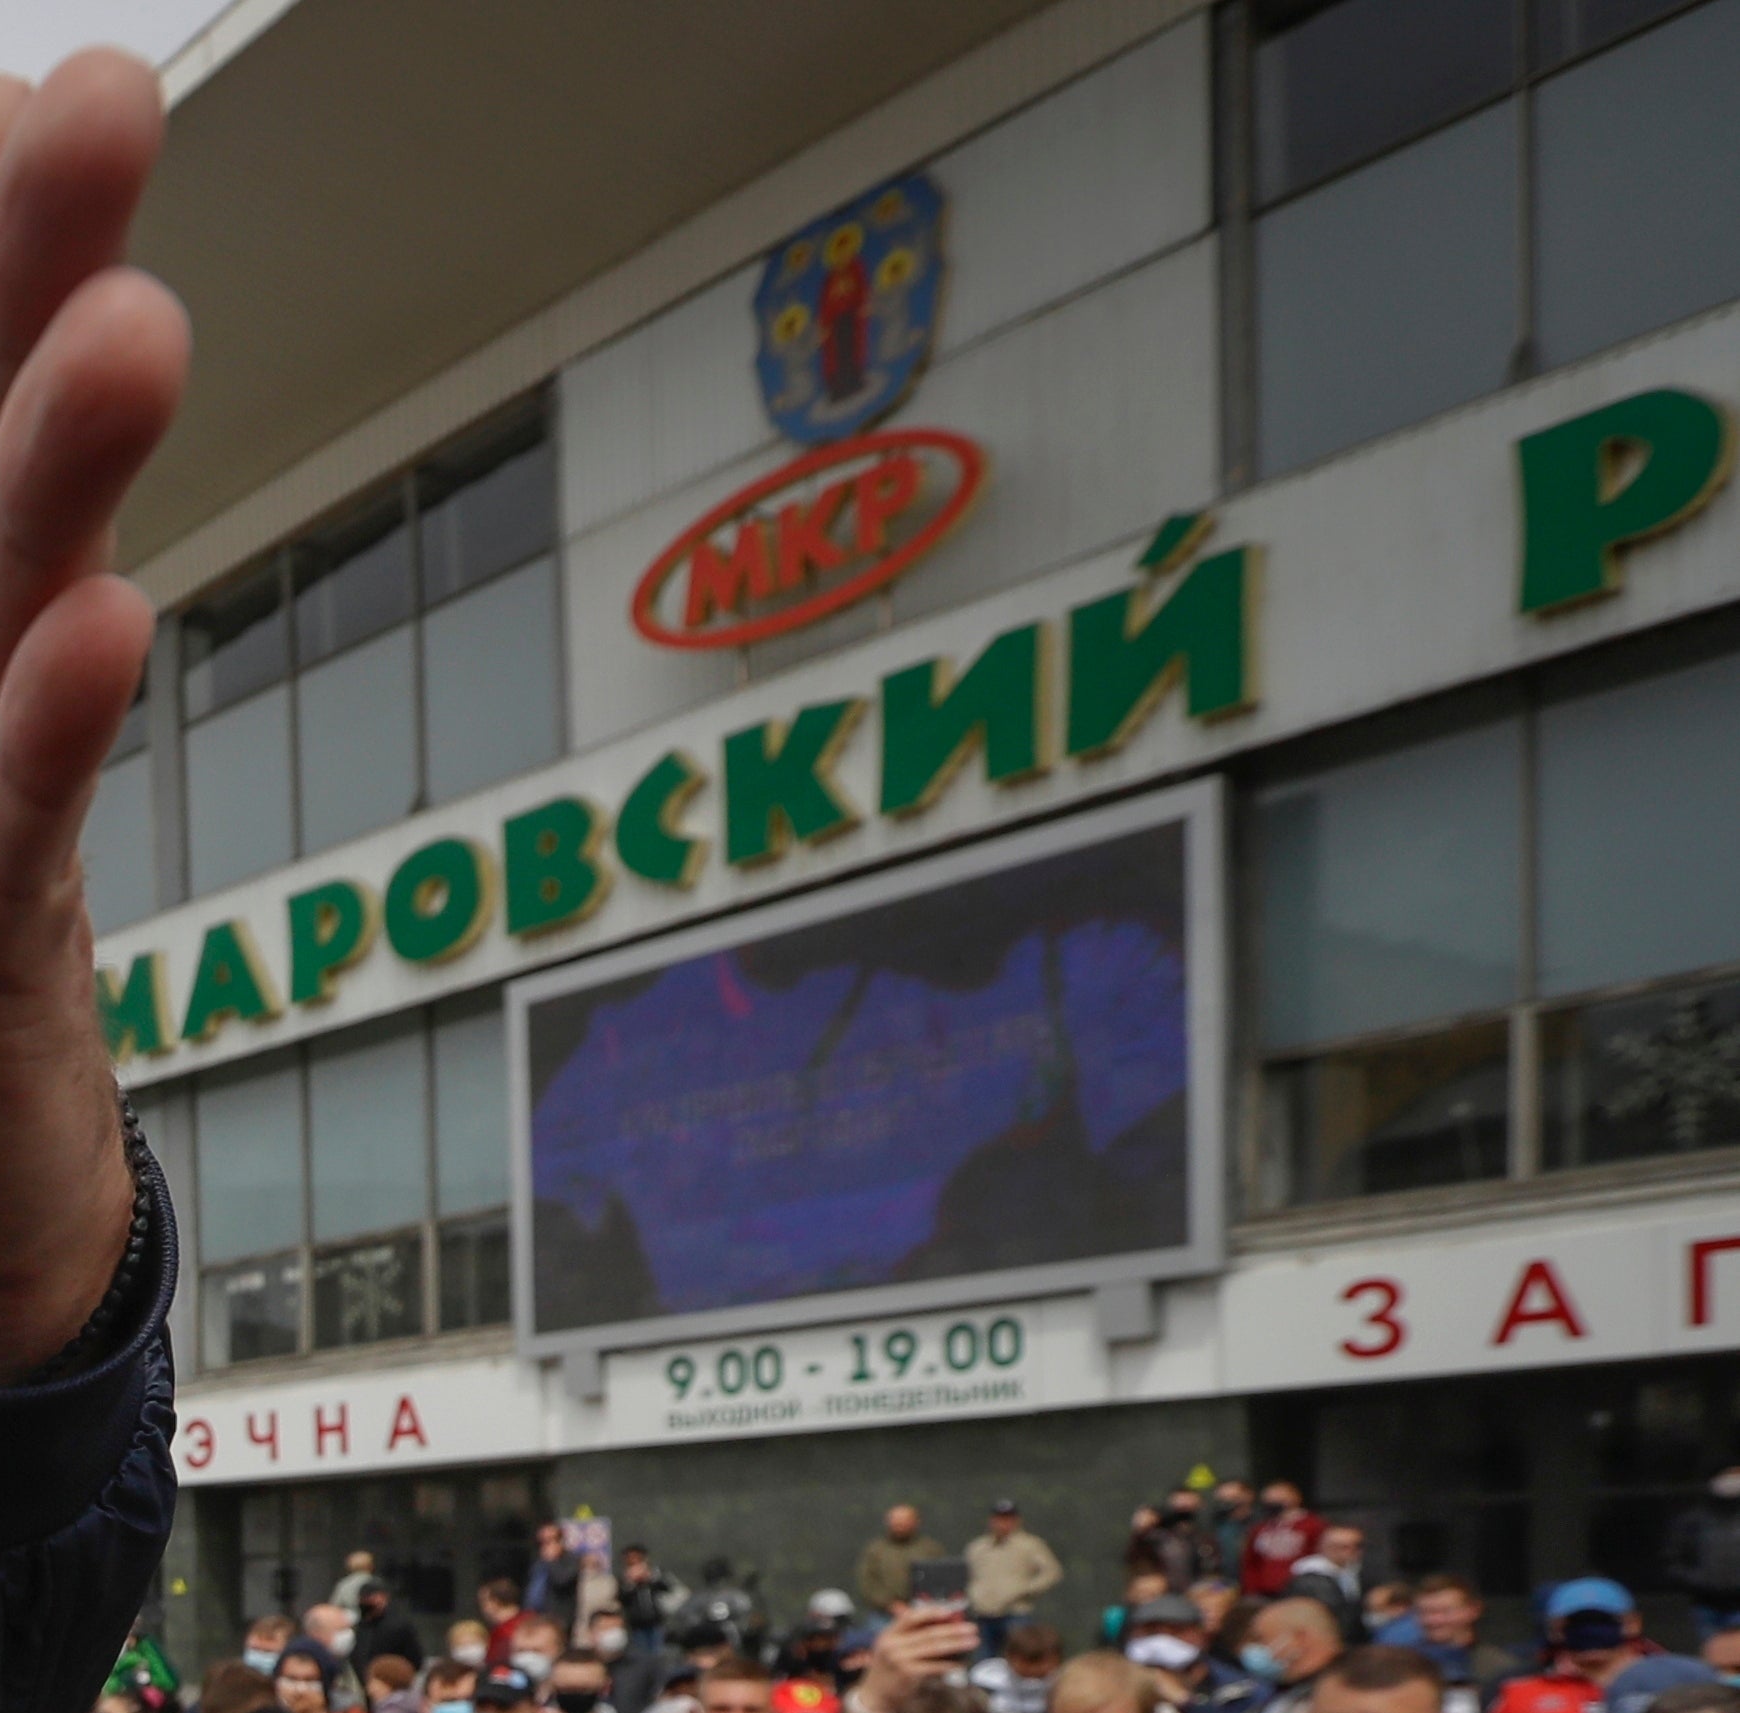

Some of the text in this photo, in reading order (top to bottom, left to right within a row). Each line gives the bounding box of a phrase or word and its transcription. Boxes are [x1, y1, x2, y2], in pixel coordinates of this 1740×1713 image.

[666, 1344, 784, 1400] 9.00
[848, 1315, 1025, 1383] 19.00
[183, 1394, 430, 1469] ЭЧНА
